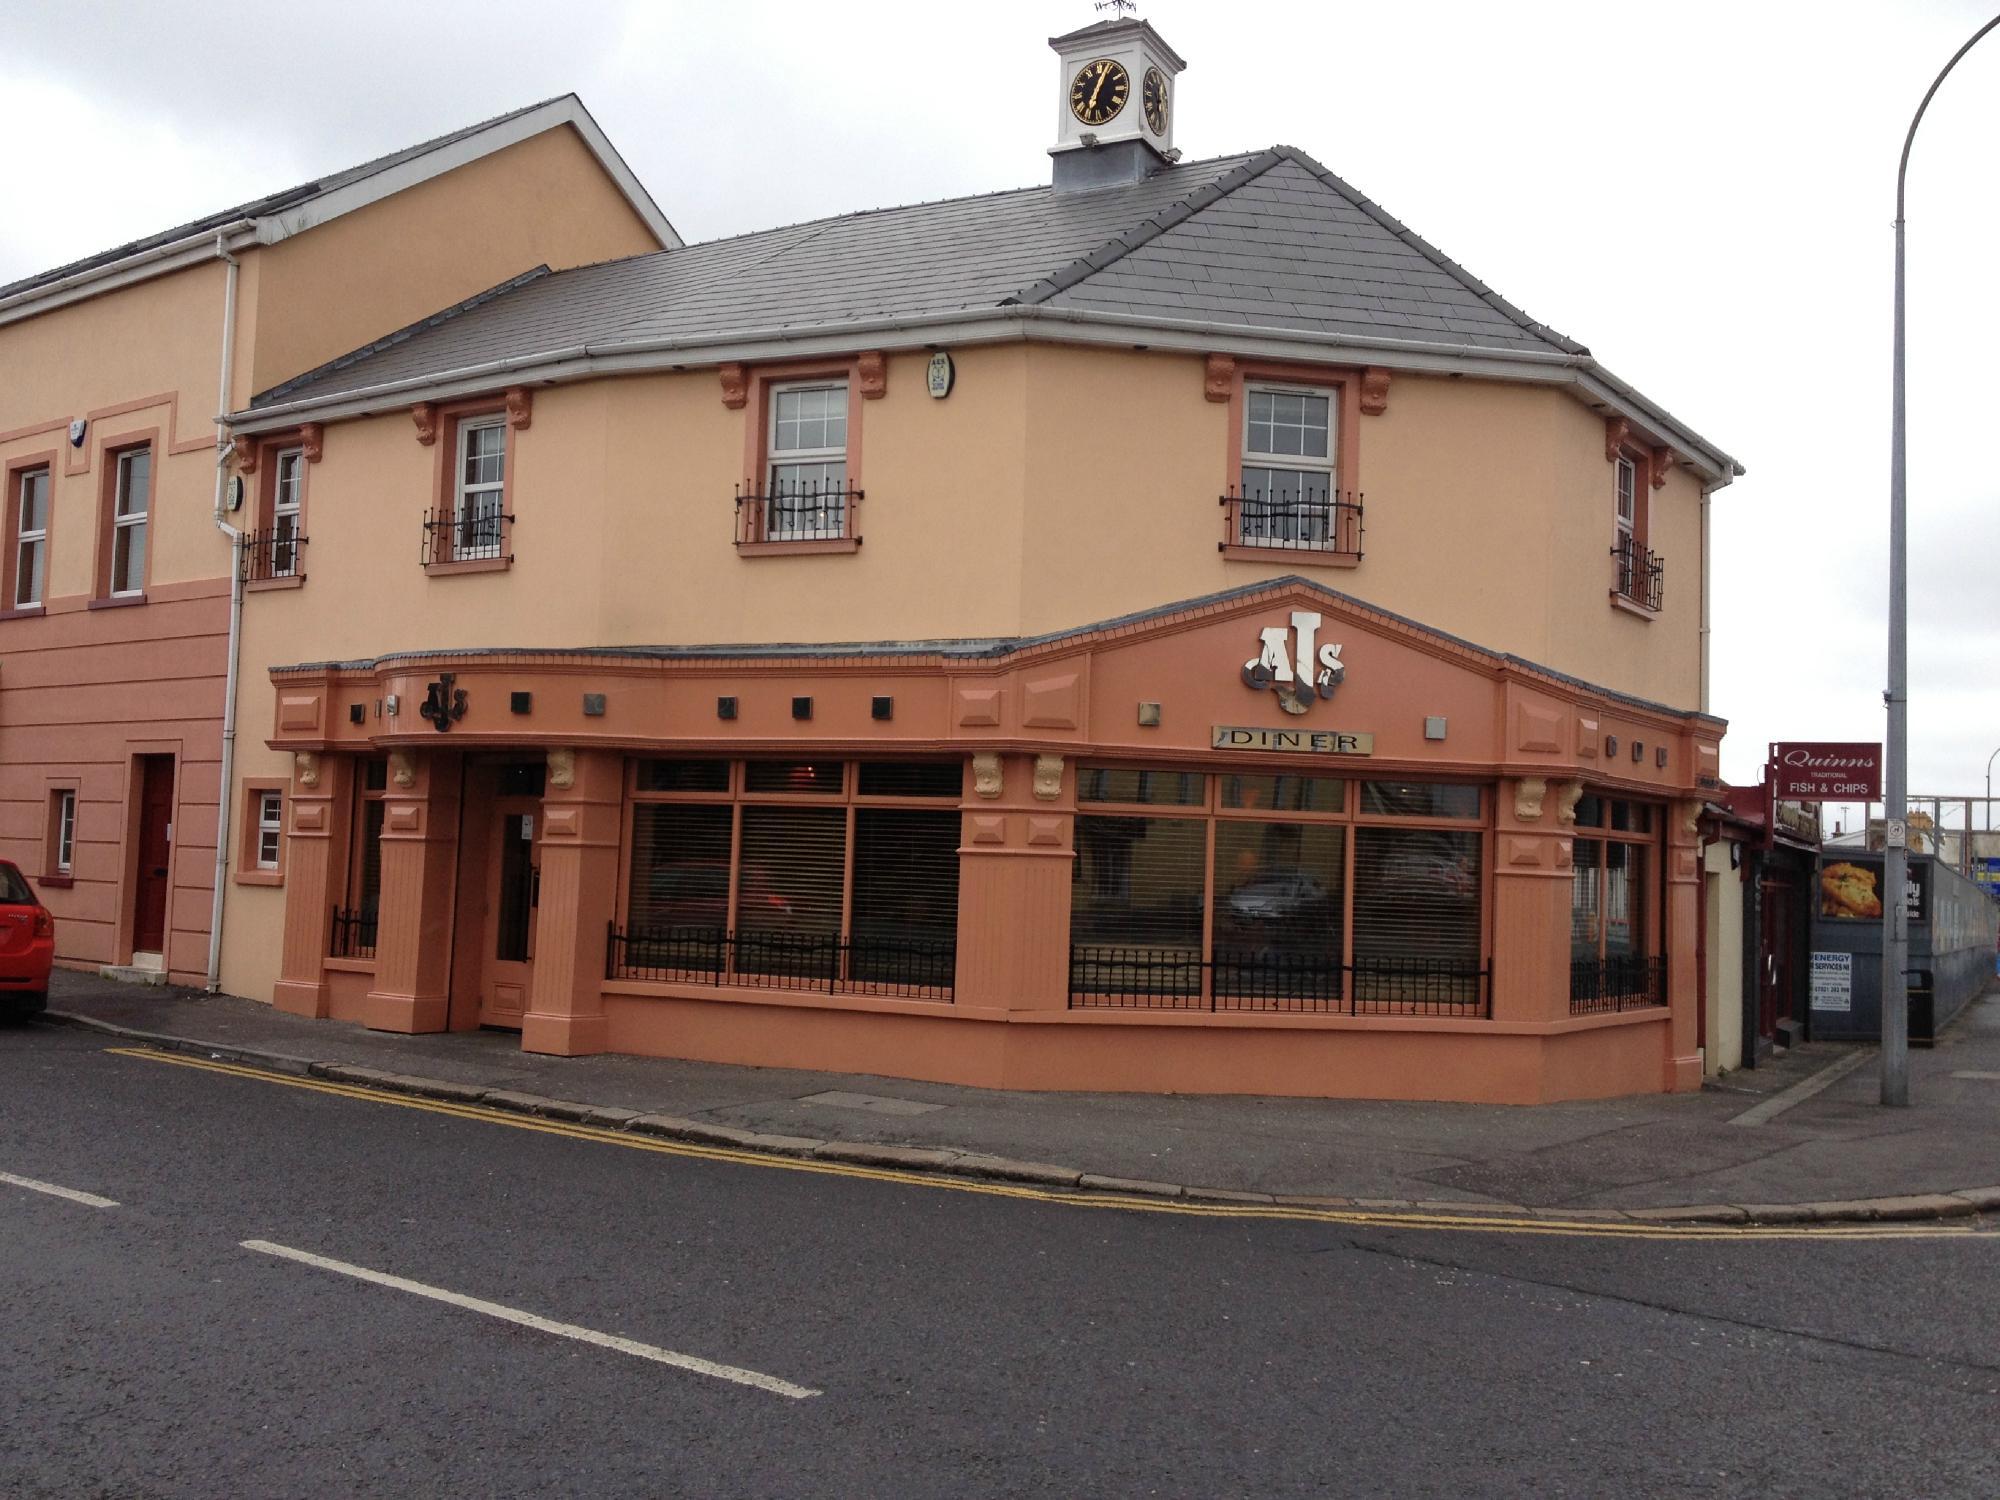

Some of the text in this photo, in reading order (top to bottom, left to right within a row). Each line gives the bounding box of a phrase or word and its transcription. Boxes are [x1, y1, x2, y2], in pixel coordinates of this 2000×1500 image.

[1231, 730, 1358, 750] DINER
[1784, 749, 1875, 768] Quinns
[1789, 782, 1869, 794] FISH & CHIPS
[1815, 954, 1850, 962] ENERGY
